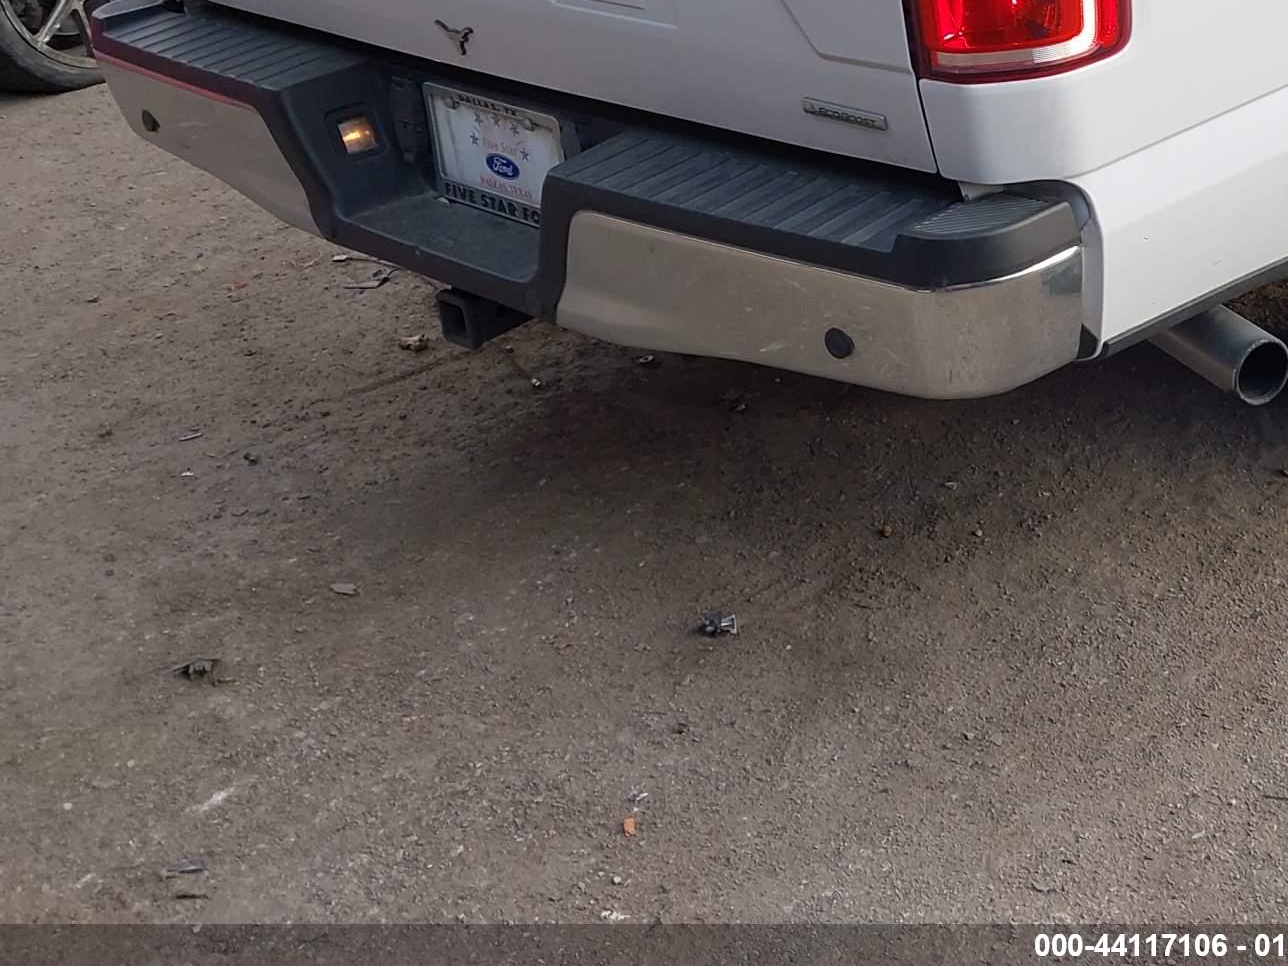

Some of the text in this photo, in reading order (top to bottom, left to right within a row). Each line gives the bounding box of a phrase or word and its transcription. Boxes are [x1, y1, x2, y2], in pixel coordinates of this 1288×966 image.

[492, 156, 514, 177] Ford
[445, 182, 540, 223] FIVE STAR FO
